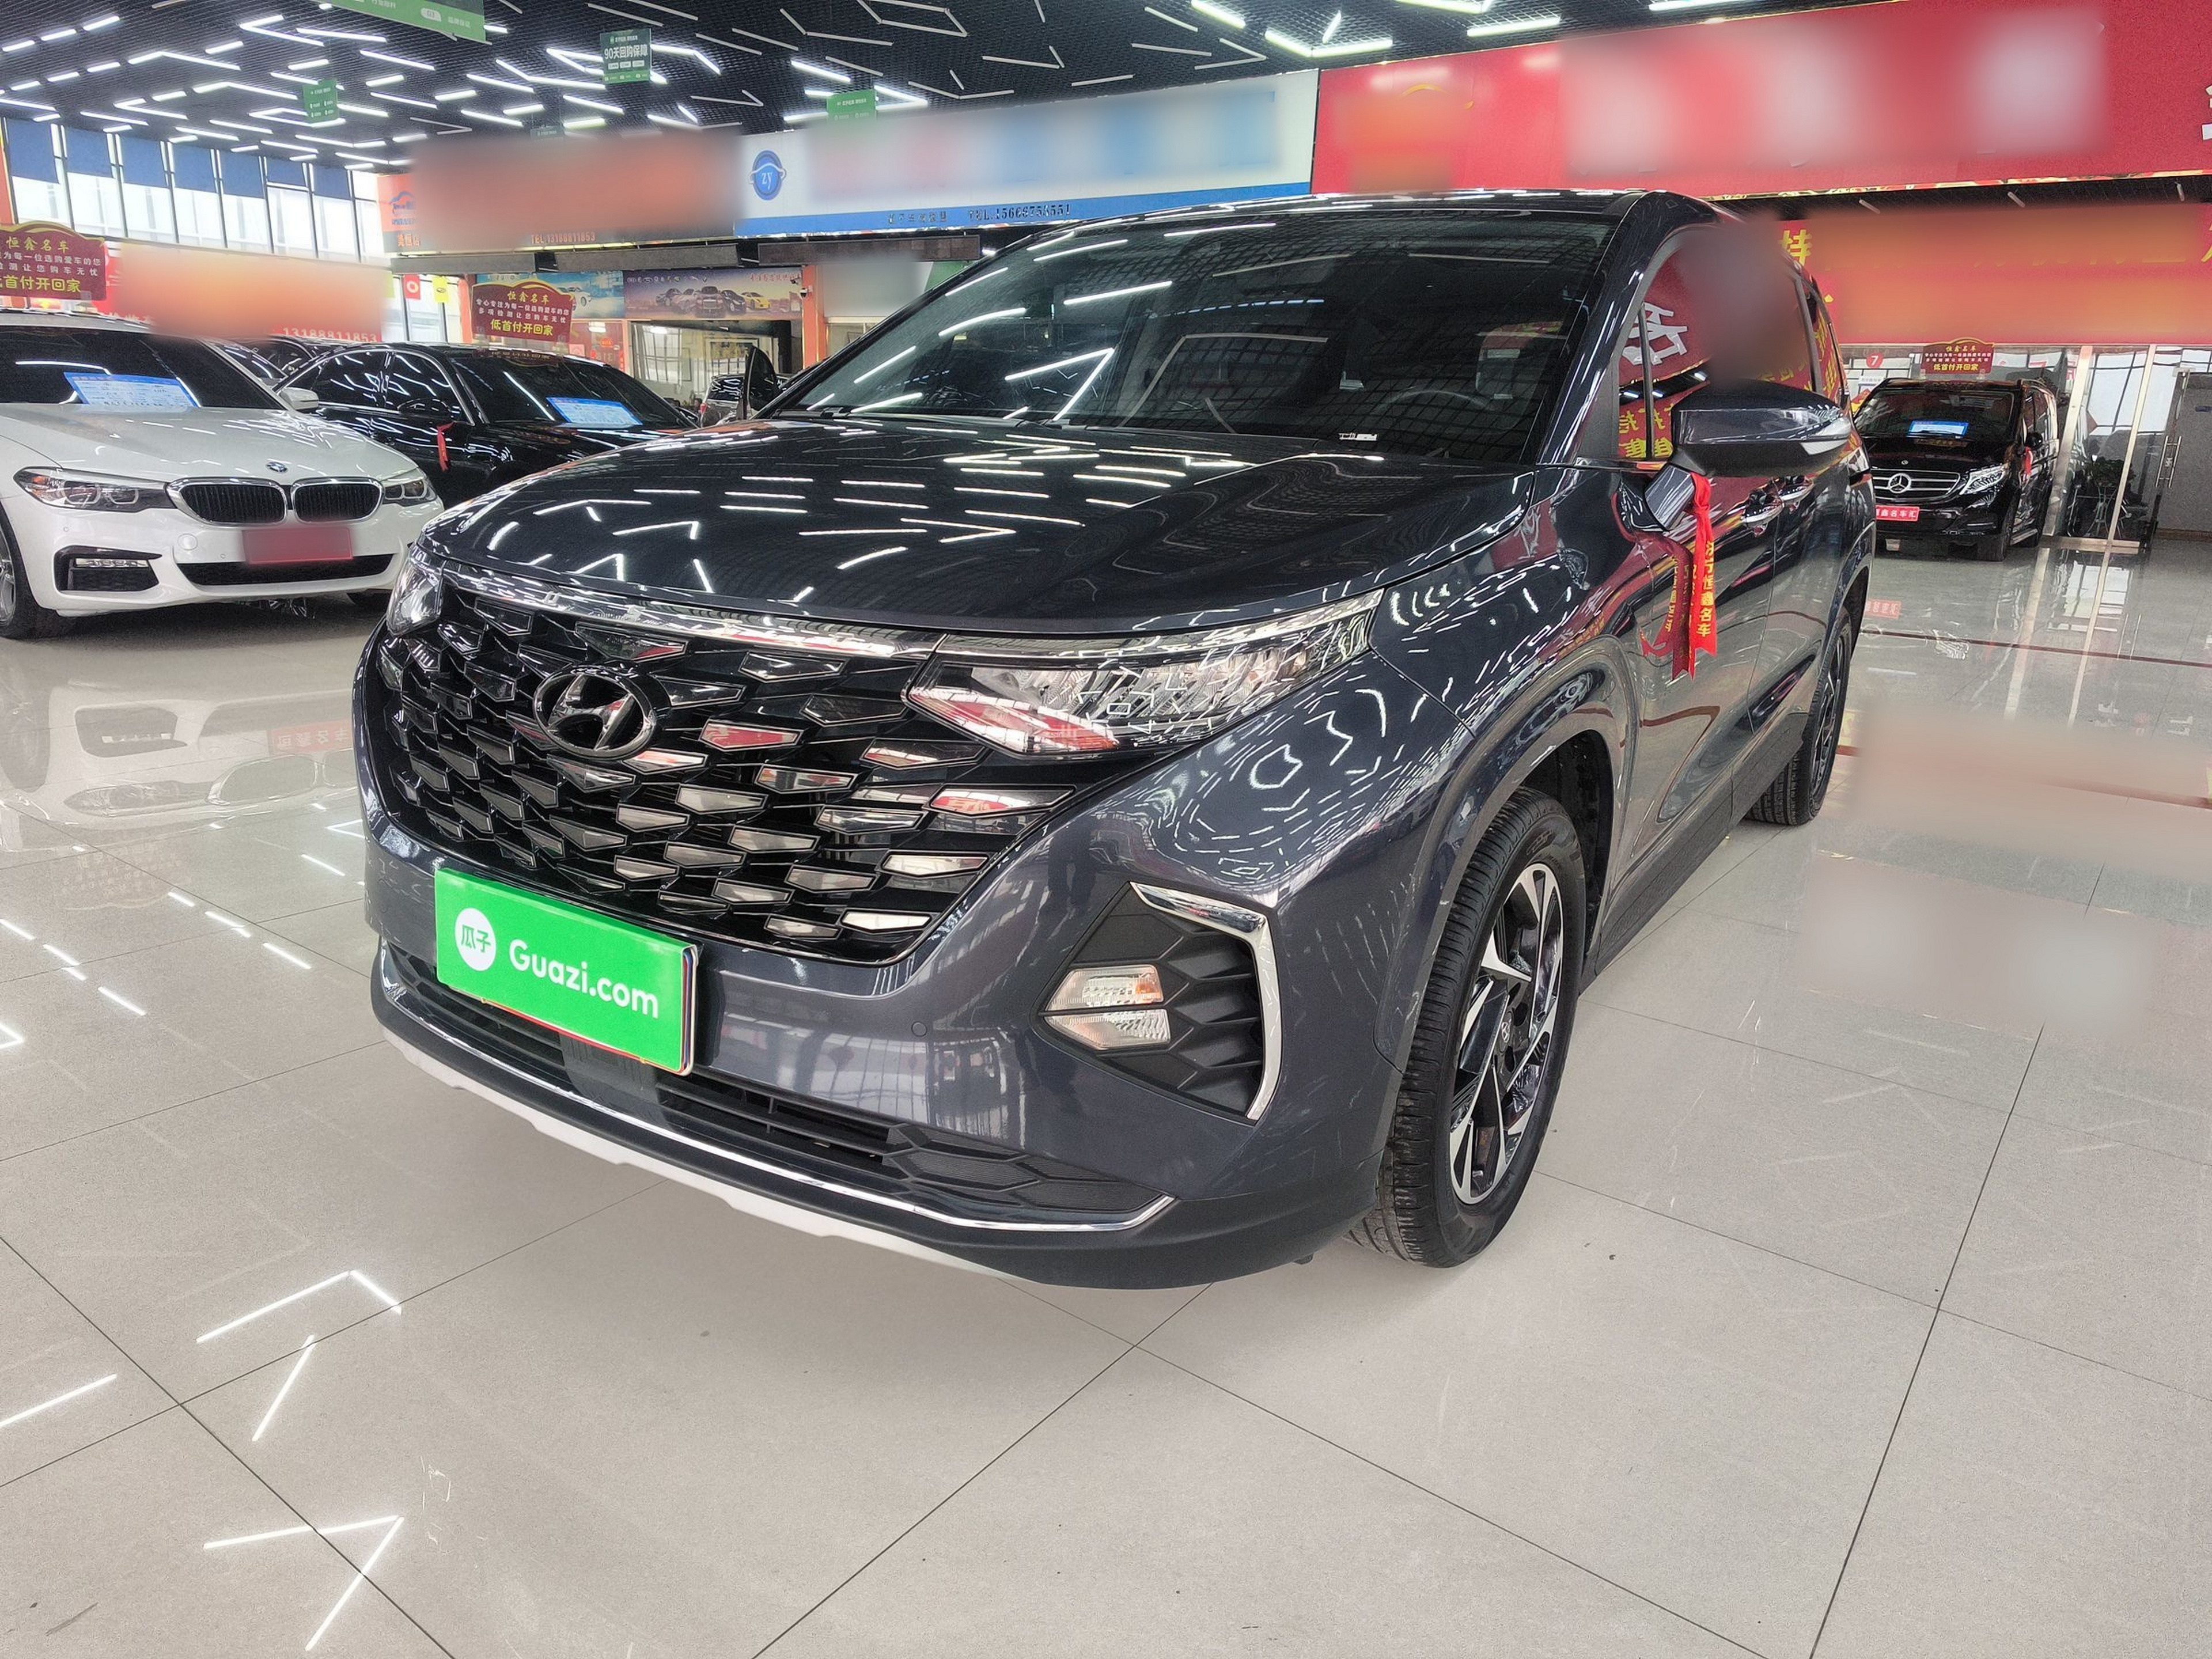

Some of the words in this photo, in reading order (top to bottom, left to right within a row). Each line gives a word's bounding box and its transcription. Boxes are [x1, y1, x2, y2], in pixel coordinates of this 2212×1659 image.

[6, 236, 70, 254] 恒鑫名车
[0, 251, 101, 267] 为每一位选购爱车的您
[0, 274, 81, 293] 首付开回家
[507, 290, 550, 305] 恒鑫名车
[490, 318, 554, 336] 低首付开回家
[1871, 355, 1879, 366] 7
[459, 923, 491, 955] 瓜子
[509, 938, 660, 1018] Guazi.com
